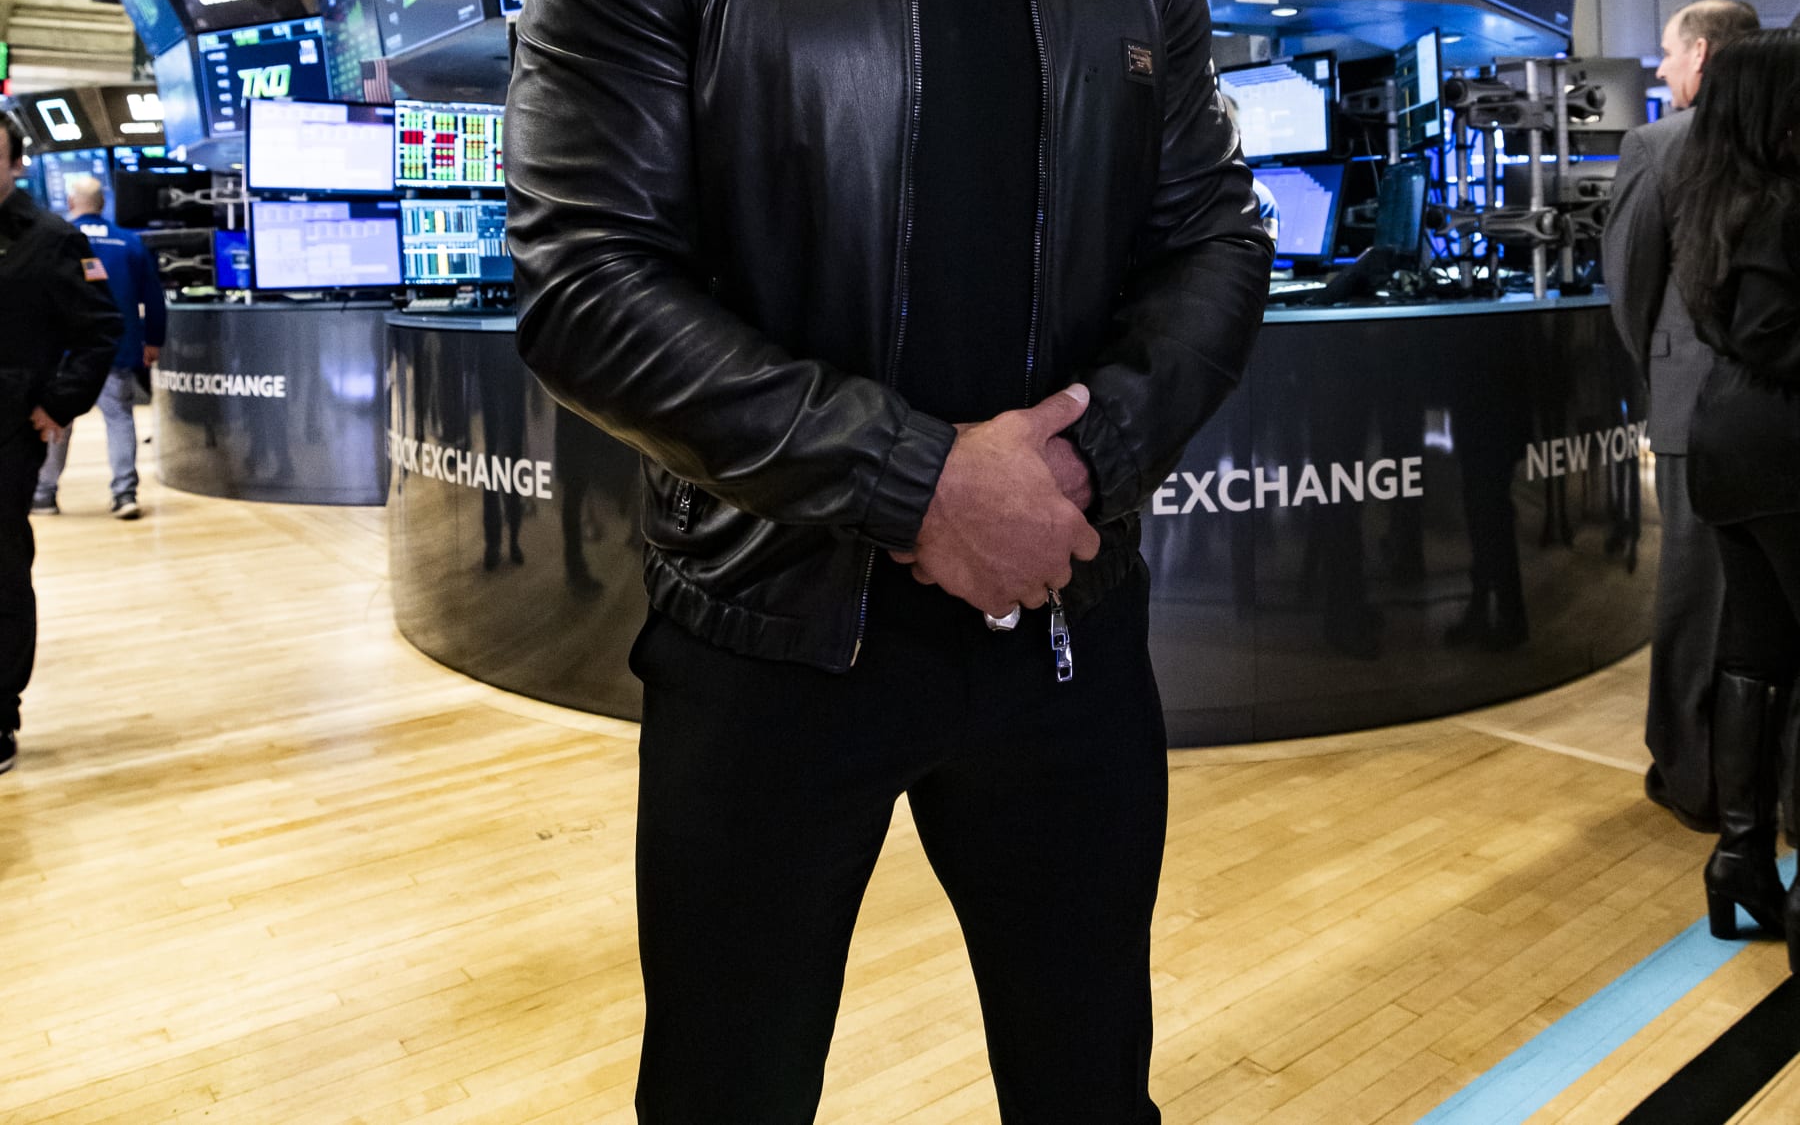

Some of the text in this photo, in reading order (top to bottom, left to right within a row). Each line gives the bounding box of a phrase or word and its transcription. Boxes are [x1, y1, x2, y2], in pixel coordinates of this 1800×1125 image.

[238, 64, 292, 100] TKO
[195, 373, 286, 398] EXCHANGE
[388, 431, 553, 500] TOCK EXCHANGE
[1526, 434, 1591, 481] NEW
[1152, 457, 1424, 515] EXCHANGE
